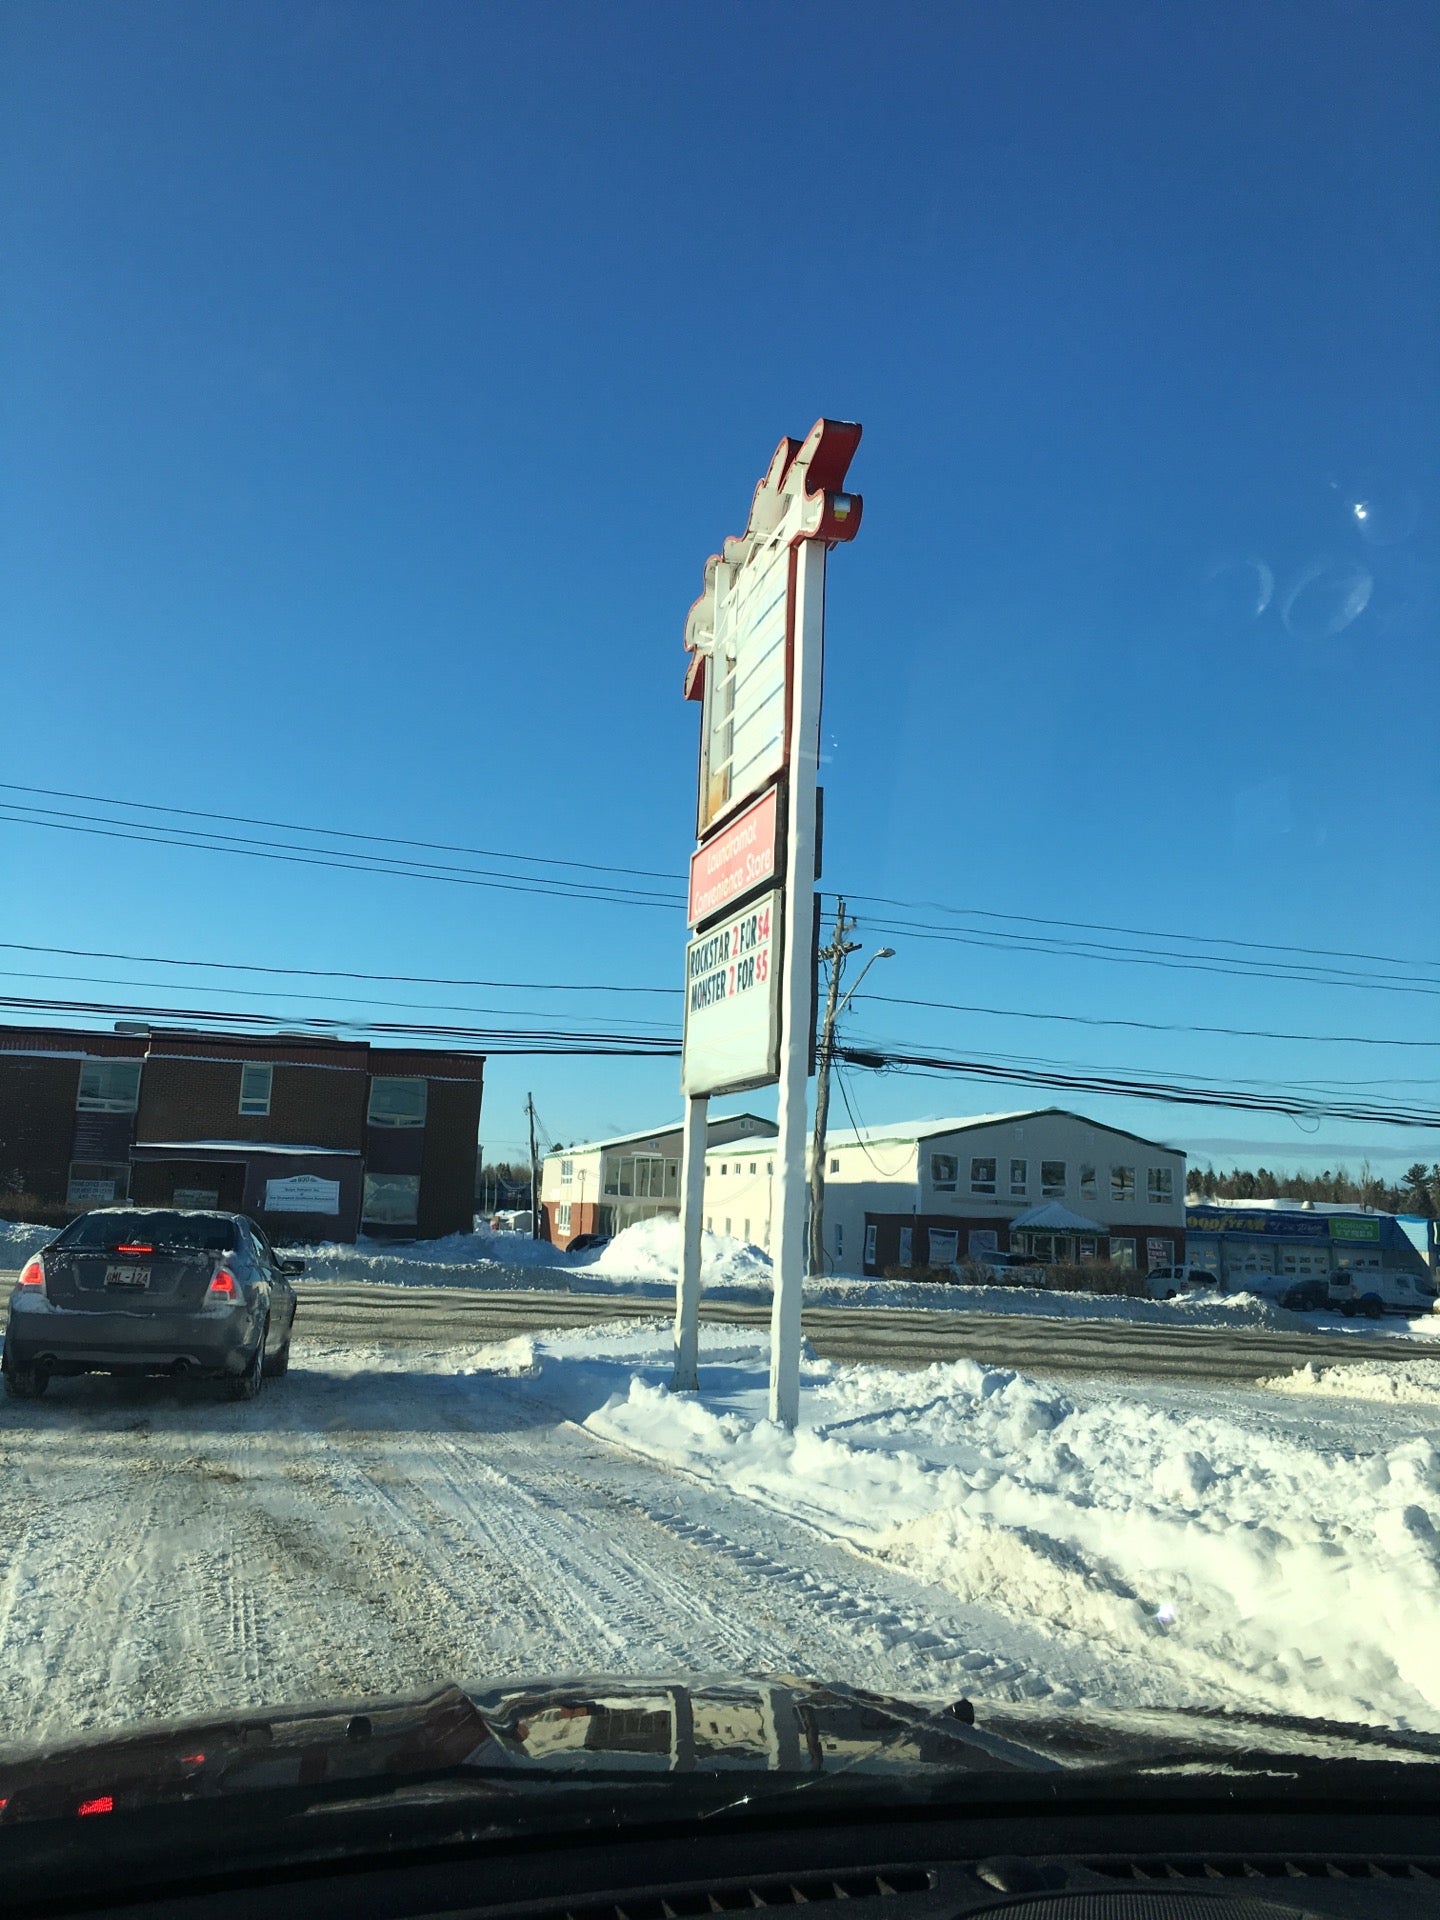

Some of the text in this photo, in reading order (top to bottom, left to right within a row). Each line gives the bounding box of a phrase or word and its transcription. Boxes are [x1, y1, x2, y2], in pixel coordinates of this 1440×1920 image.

[695, 848, 772, 917] Convenience Store
[690, 907, 770, 979] ROCKSTAR 2 FOR $4
[690, 949, 768, 1013] MONSTER 2 FOR $5
